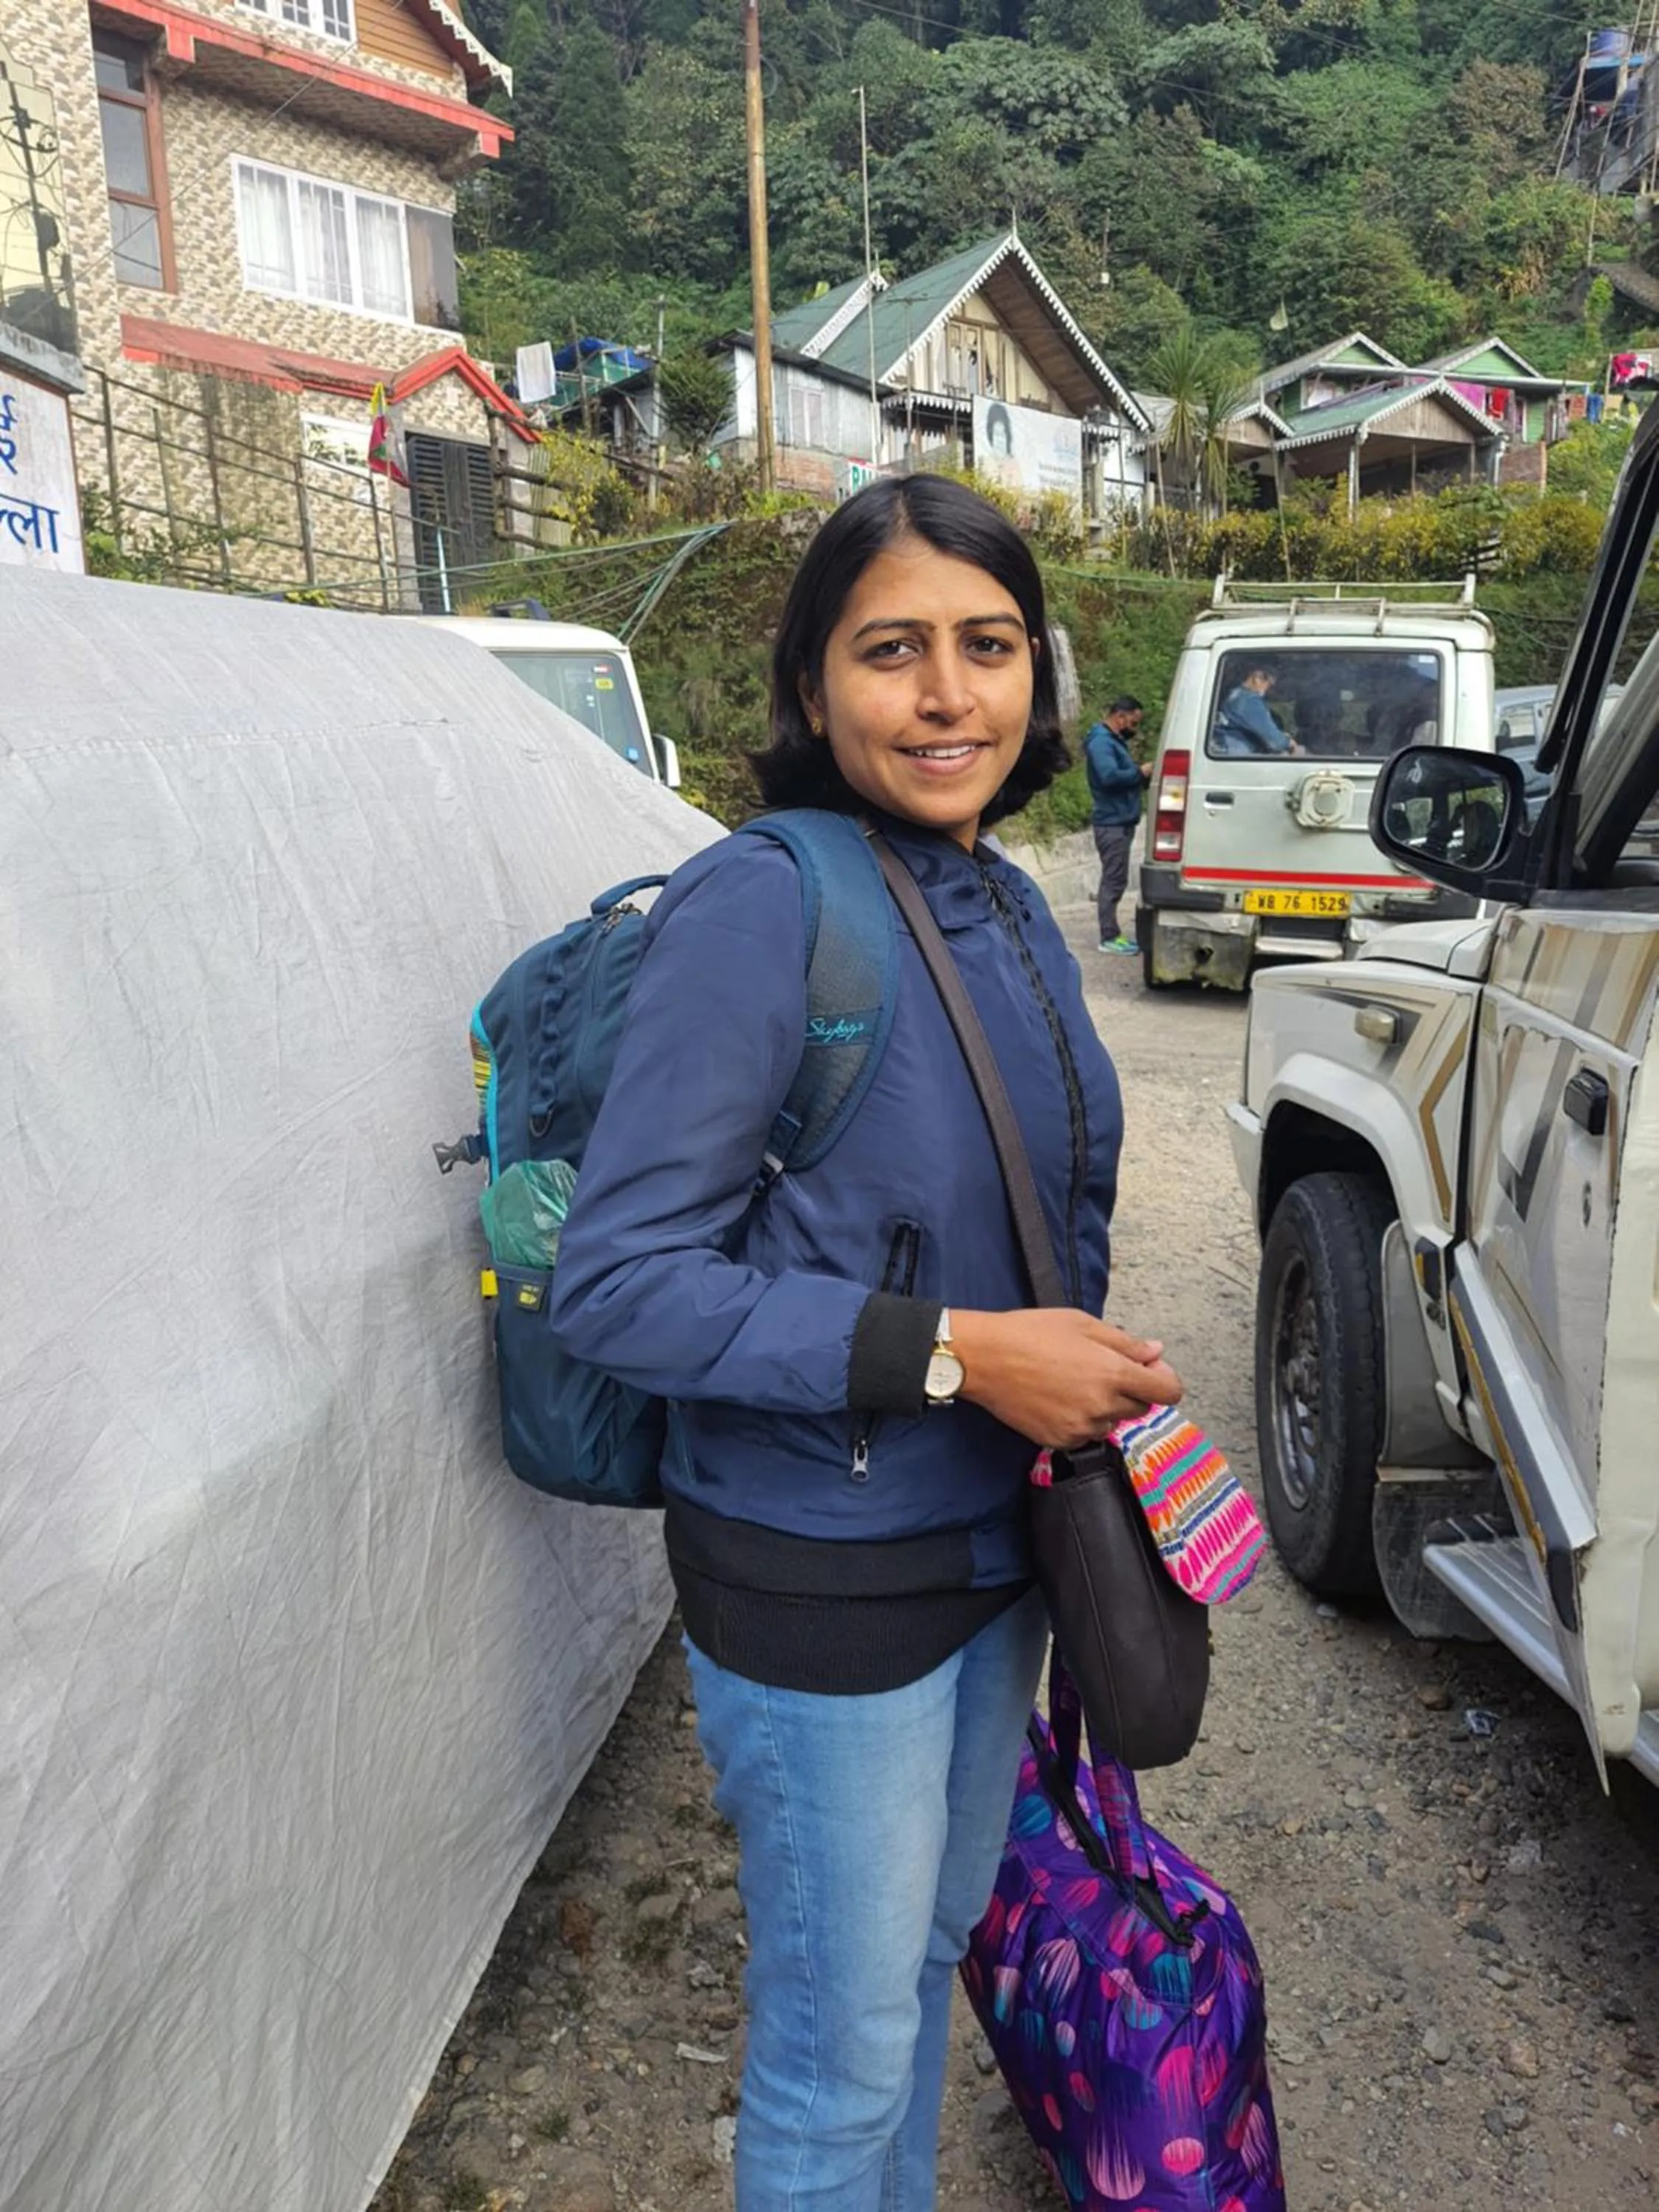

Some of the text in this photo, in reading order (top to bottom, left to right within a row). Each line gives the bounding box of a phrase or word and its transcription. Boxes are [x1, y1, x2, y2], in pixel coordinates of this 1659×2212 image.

[1258, 895, 1348, 912] WB 76 1529
